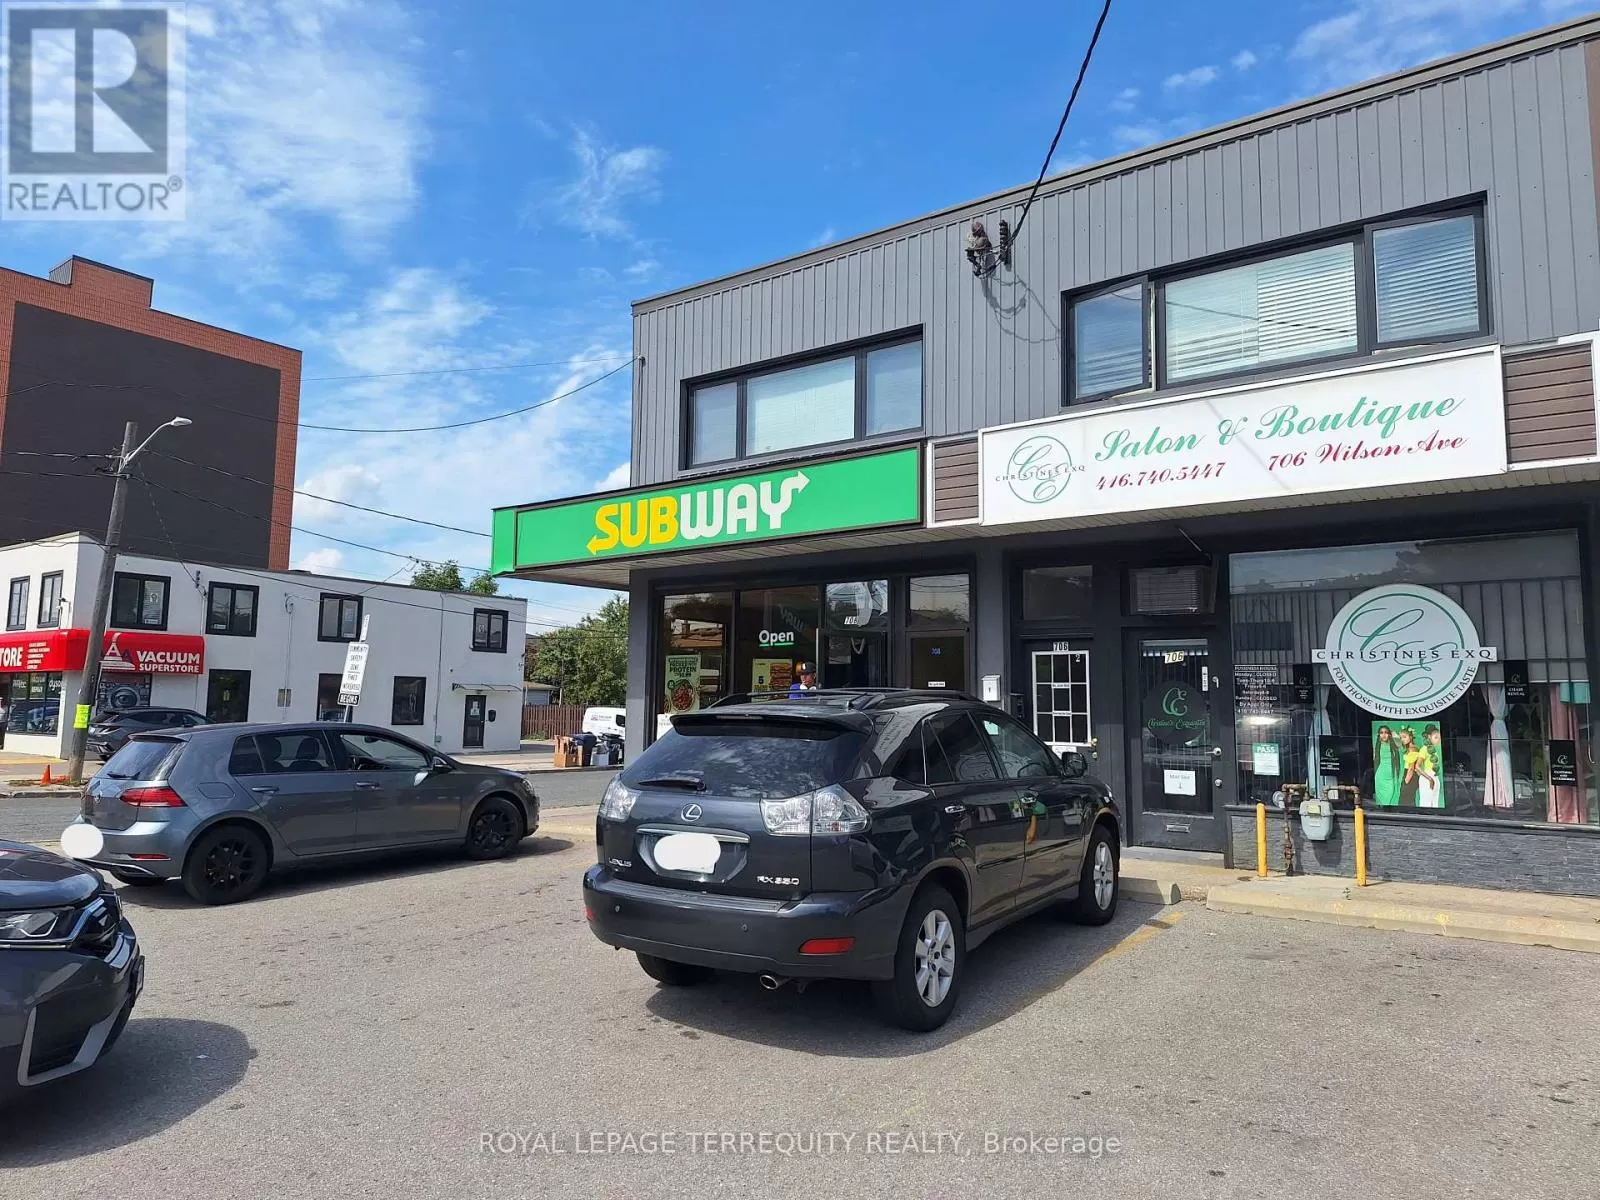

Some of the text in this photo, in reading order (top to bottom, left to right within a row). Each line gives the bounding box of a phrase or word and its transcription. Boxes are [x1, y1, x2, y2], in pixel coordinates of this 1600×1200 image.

[1095, 396, 1466, 462] Salon & Boutique
[1268, 430, 1468, 471] 706 Wilson Ave
[1096, 462, 1226, 490] 416.740.5447
[586, 471, 811, 555] SUBWAY
[758, 629, 795, 646] Open
[1053, 642, 1069, 651] 706
[136, 651, 200, 664] VACUUM
[1075, 654, 1081, 662] 2
[1166, 651, 1185, 663] 706
[1316, 649, 1494, 661] CHRISTINES EXQ
[139, 664, 200, 673] SUPERSTORE
[1332, 666, 1477, 715] FOR THOSE WITH EXQUISITE TASTE
[339, 693, 359, 705] BEGINS
[608, 857, 632, 868] LEXUS
[757, 875, 774, 884] RX
